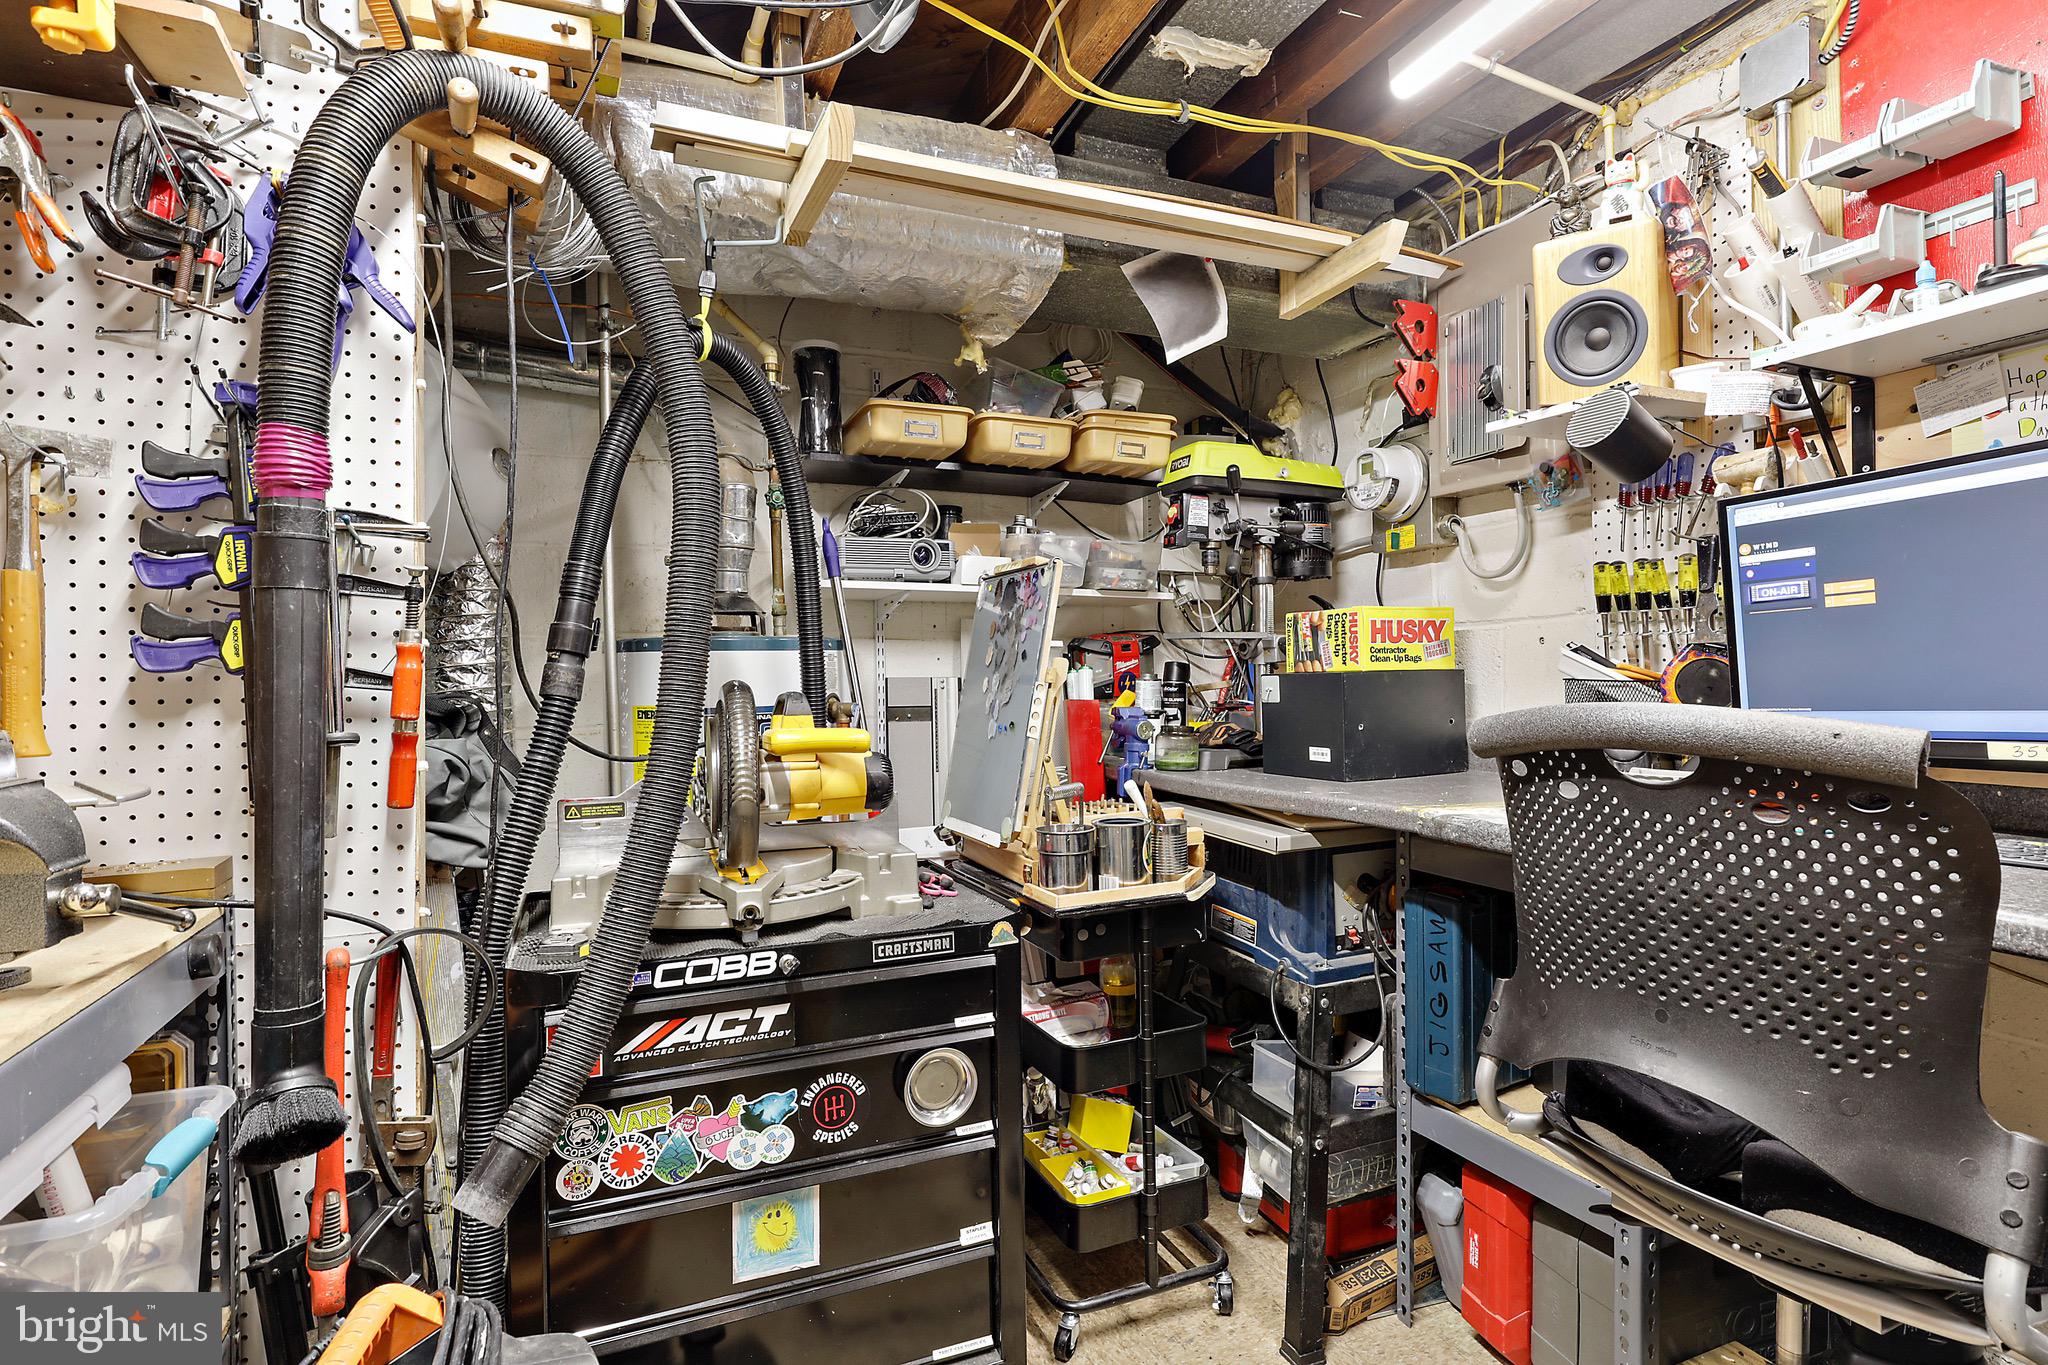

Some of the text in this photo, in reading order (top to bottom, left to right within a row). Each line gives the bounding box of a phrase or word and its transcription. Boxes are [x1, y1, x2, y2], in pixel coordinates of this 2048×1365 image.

[2006, 368, 2048, 389] Hap
[2007, 390, 2048, 414] Fath
[1171, 457, 1190, 471] RYOBI
[234, 539, 248, 574] IRWIN
[358, 584, 388, 595] GERMANY
[1760, 585, 1799, 598] ON-AIR
[1286, 616, 1294, 629] 32
[1326, 614, 1334, 640] Bags
[1369, 618, 1448, 645] HUSKY
[1340, 612, 1348, 667] Contractor
[1348, 612, 1360, 665] HUSKY
[1370, 646, 1407, 654] Contractor
[1404, 654, 1422, 663] Bags
[353, 677, 383, 685] GERMANY
[877, 937, 951, 957] CRAFTSMAN
[653, 950, 778, 989] COBB
[1428, 909, 1450, 1057] JIGSAW
[654, 1002, 792, 1050] ACT
[613, 1029, 792, 1063] ADVANCED CLUTCH TECHNOLOGY
[800, 1071, 867, 1108] ENDANGERED
[580, 1108, 607, 1127] WARS
[606, 1098, 672, 1136] VANS
[705, 1127, 736, 1146] OUCH
[812, 1121, 860, 1144] SPECIES
[563, 1139, 603, 1157] COFFEE
[572, 1159, 593, 1167] VOTED
[571, 1189, 593, 1200] VOTED
[1377, 1265, 1391, 1277] CS
